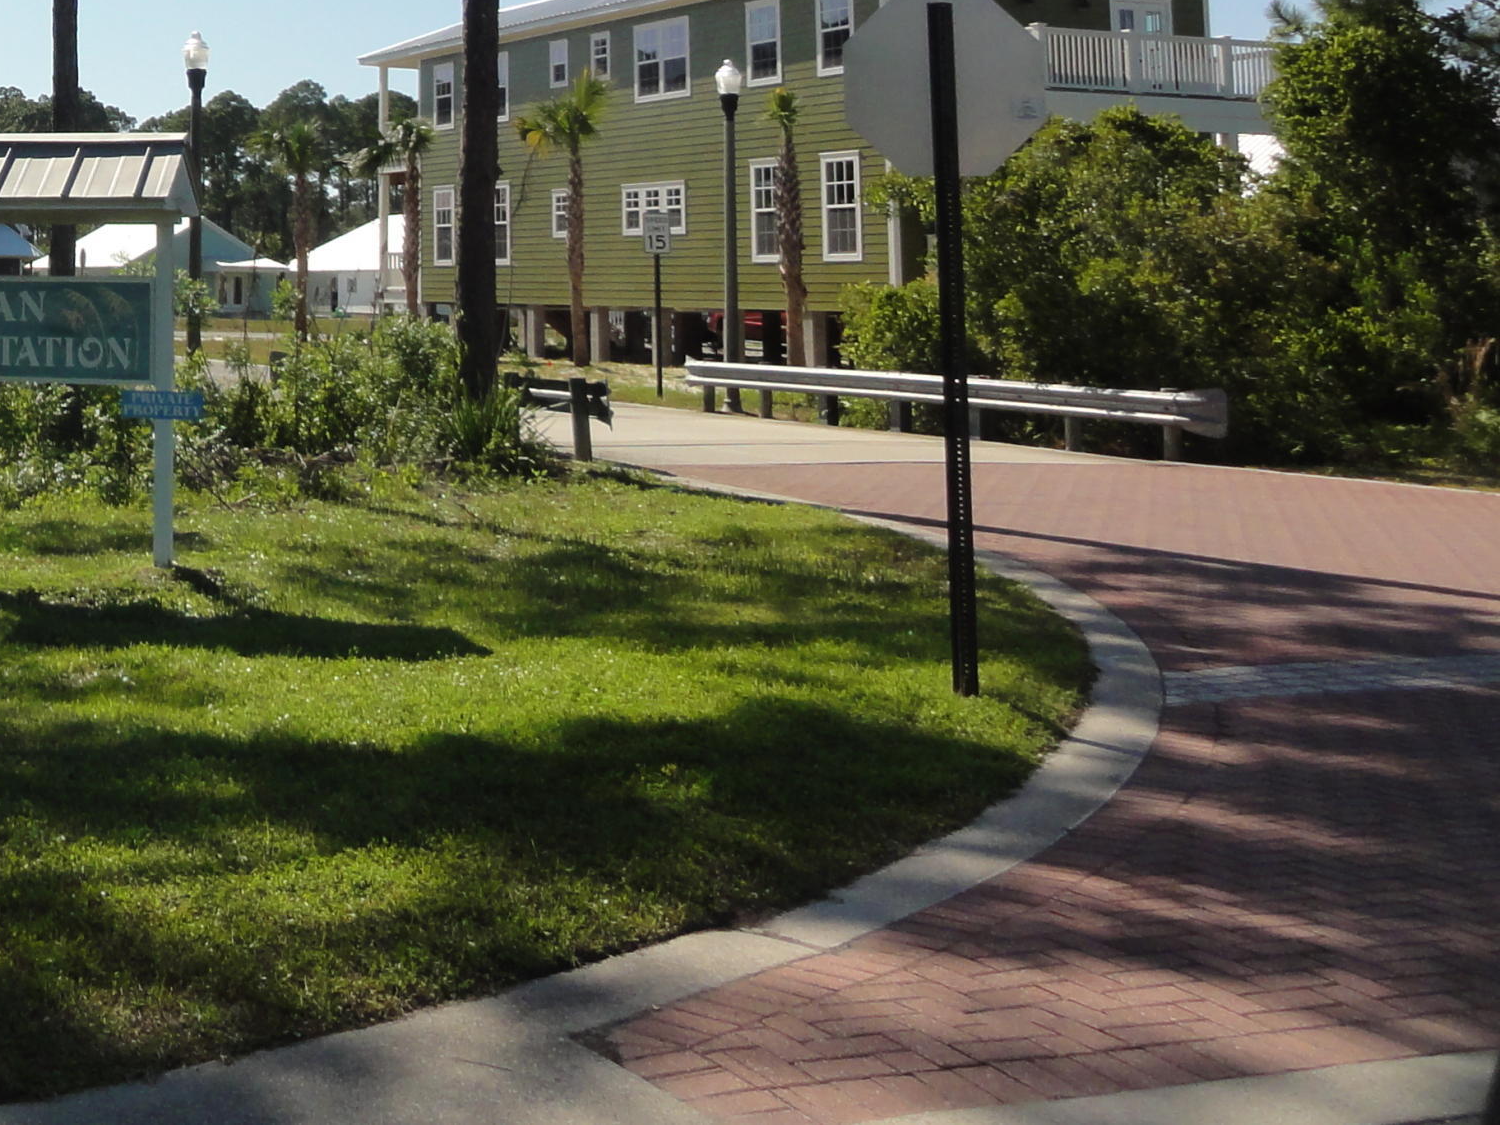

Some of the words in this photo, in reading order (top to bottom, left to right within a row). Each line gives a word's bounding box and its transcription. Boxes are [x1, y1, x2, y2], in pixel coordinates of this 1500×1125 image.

[648, 234, 666, 250] 15
[131, 392, 194, 405] PRIVATE
[123, 404, 199, 417] PROPERTY
